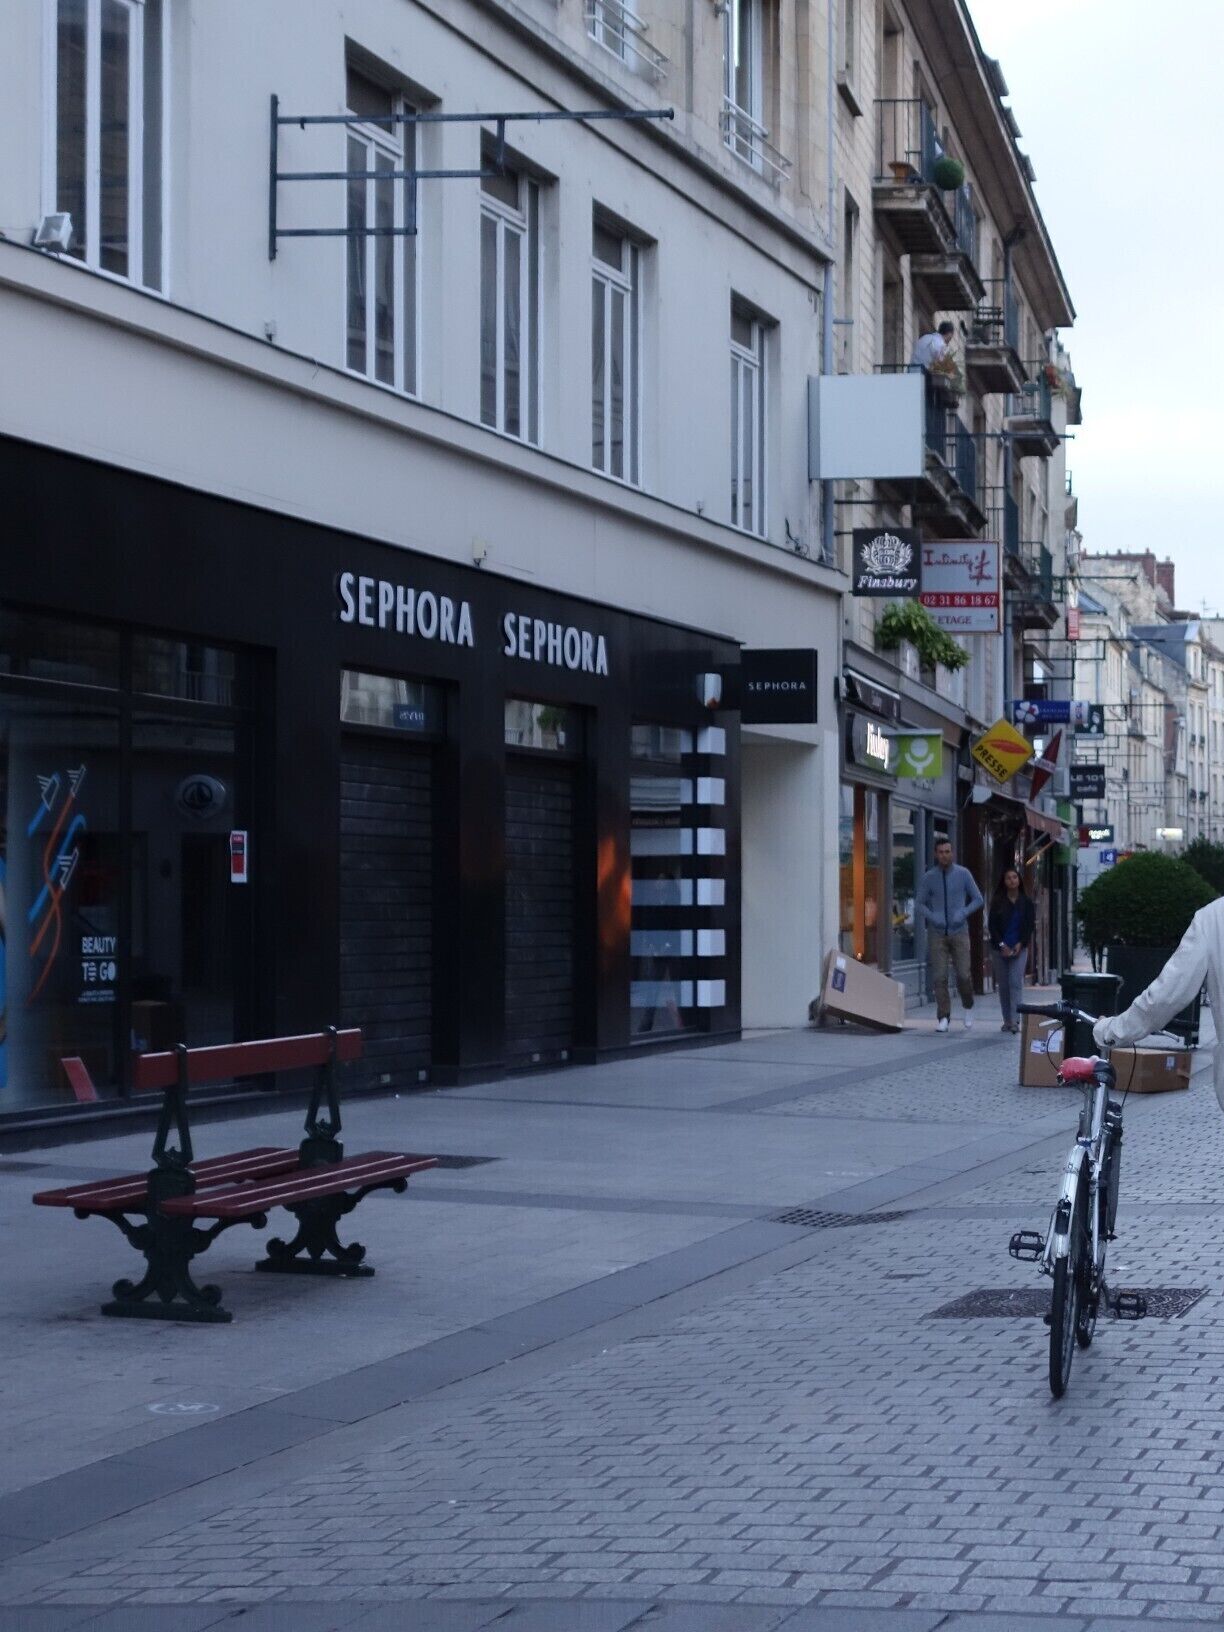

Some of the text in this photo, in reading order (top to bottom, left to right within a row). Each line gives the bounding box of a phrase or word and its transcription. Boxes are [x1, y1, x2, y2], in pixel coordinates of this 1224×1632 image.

[857, 575, 918, 591] Finsbury
[339, 571, 474, 647] SEPHORA
[924, 595, 997, 606] 02 31 86 18 67
[503, 611, 609, 676] SEPHORA
[748, 681, 807, 691] SEPHORA
[974, 745, 1008, 778] PRESSE
[82, 936, 116, 953] BEAUTY
[82, 962, 116, 982] TO GO
